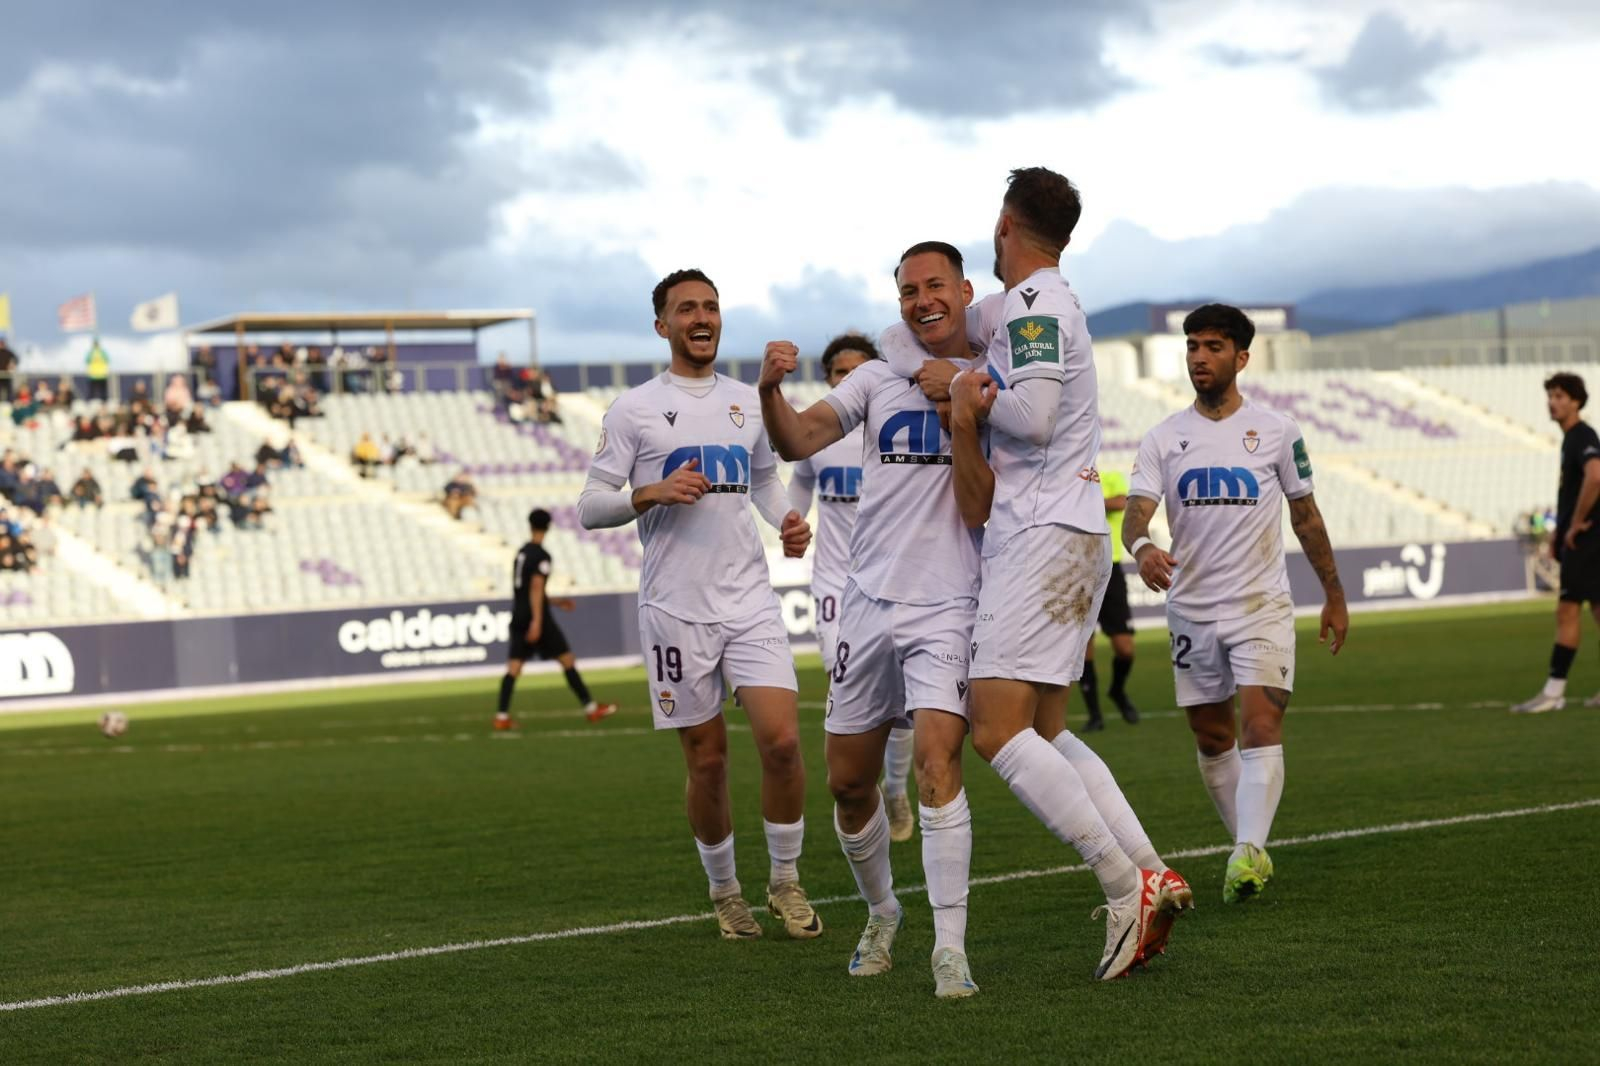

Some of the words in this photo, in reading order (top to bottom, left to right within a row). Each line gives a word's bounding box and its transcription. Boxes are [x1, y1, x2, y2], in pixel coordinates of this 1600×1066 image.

[1014, 344, 1028, 355] CAJA
[1029, 342, 1055, 350] RURAL
[883, 455, 945, 464] AMSYS
[652, 644, 683, 683] 19
